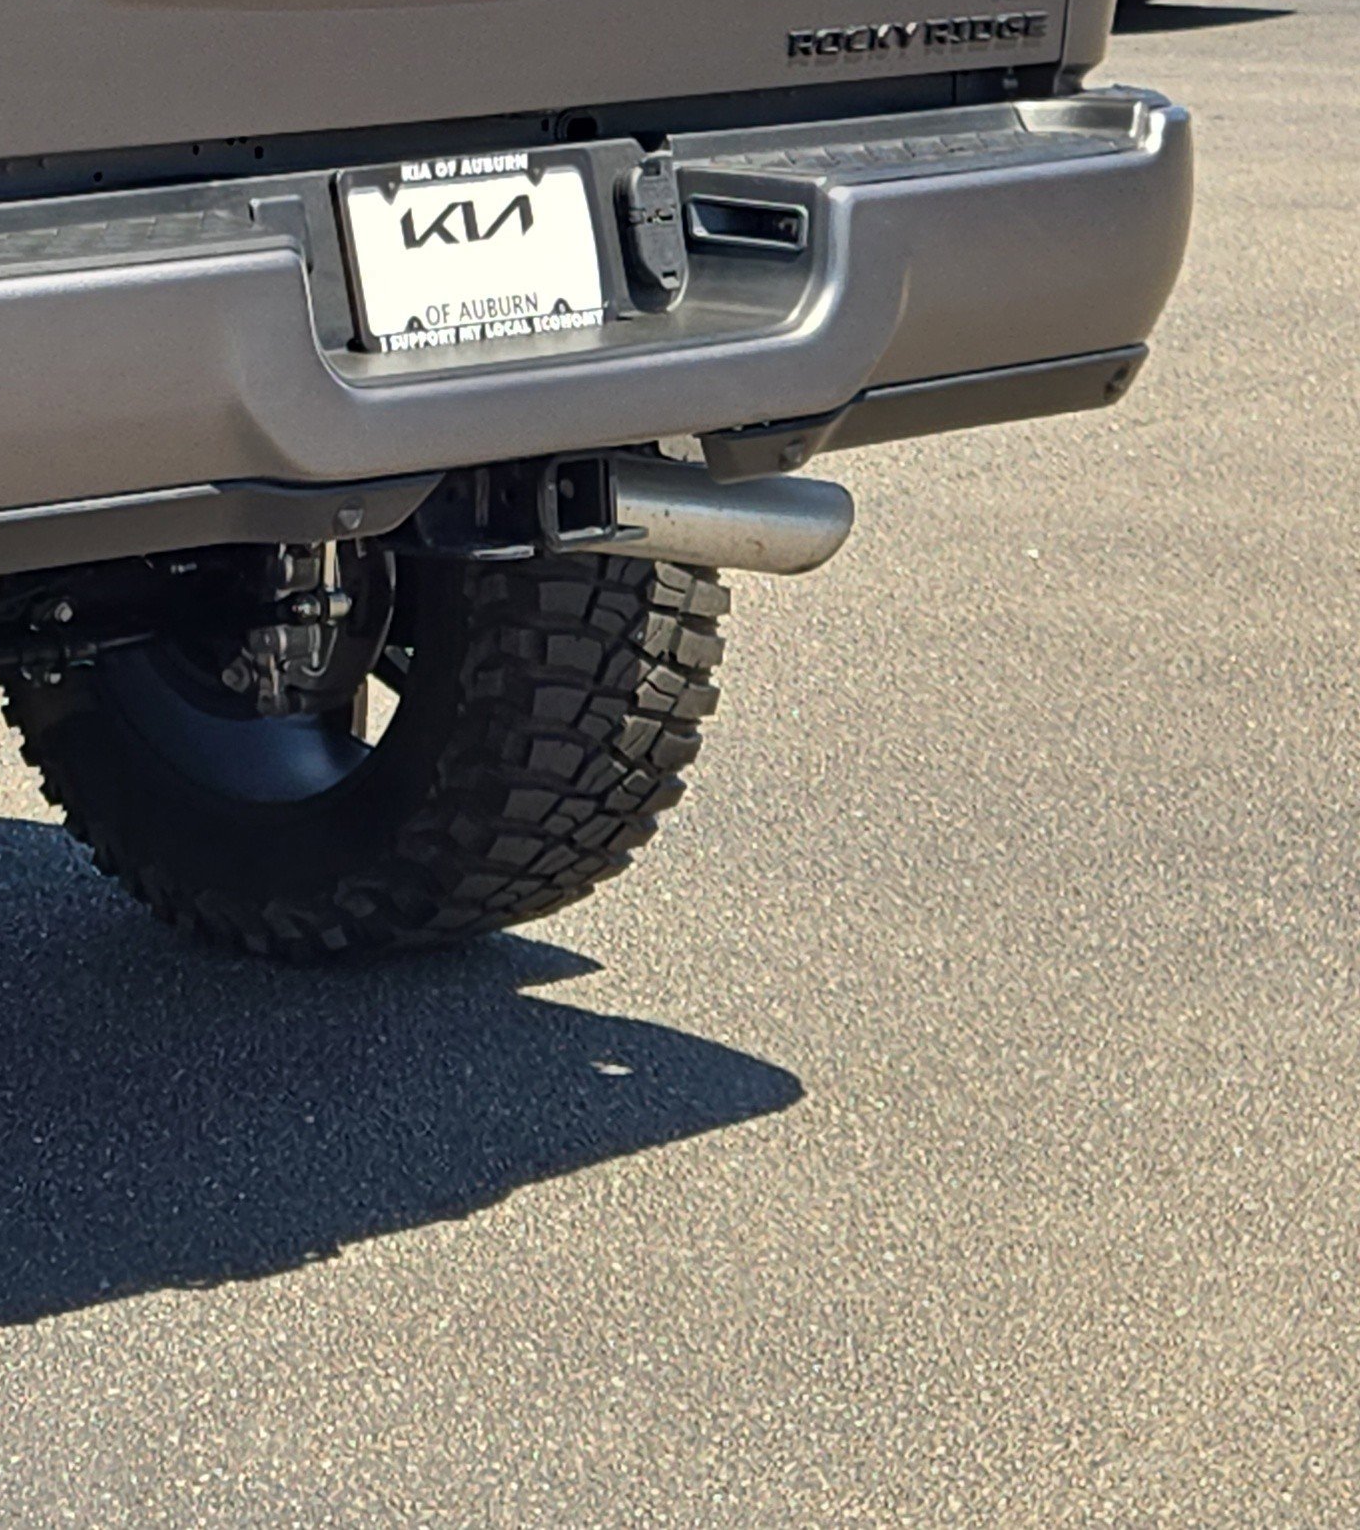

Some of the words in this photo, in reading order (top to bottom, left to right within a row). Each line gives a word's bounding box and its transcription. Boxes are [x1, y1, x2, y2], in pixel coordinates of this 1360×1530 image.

[788, 22, 918, 57] ROCKY
[924, 10, 1048, 46] RIDGE
[401, 161, 432, 182] KIA
[435, 160, 457, 178] OF
[461, 153, 528, 175] AUBURN
[400, 194, 534, 250] KIA
[425, 303, 451, 327] OF
[459, 292, 539, 322] AUBURN
[390, 328, 457, 351] SUPPORT
[459, 324, 482, 342] MY
[484, 318, 532, 339] LOCAL
[533, 310, 603, 333] ECONOMY
